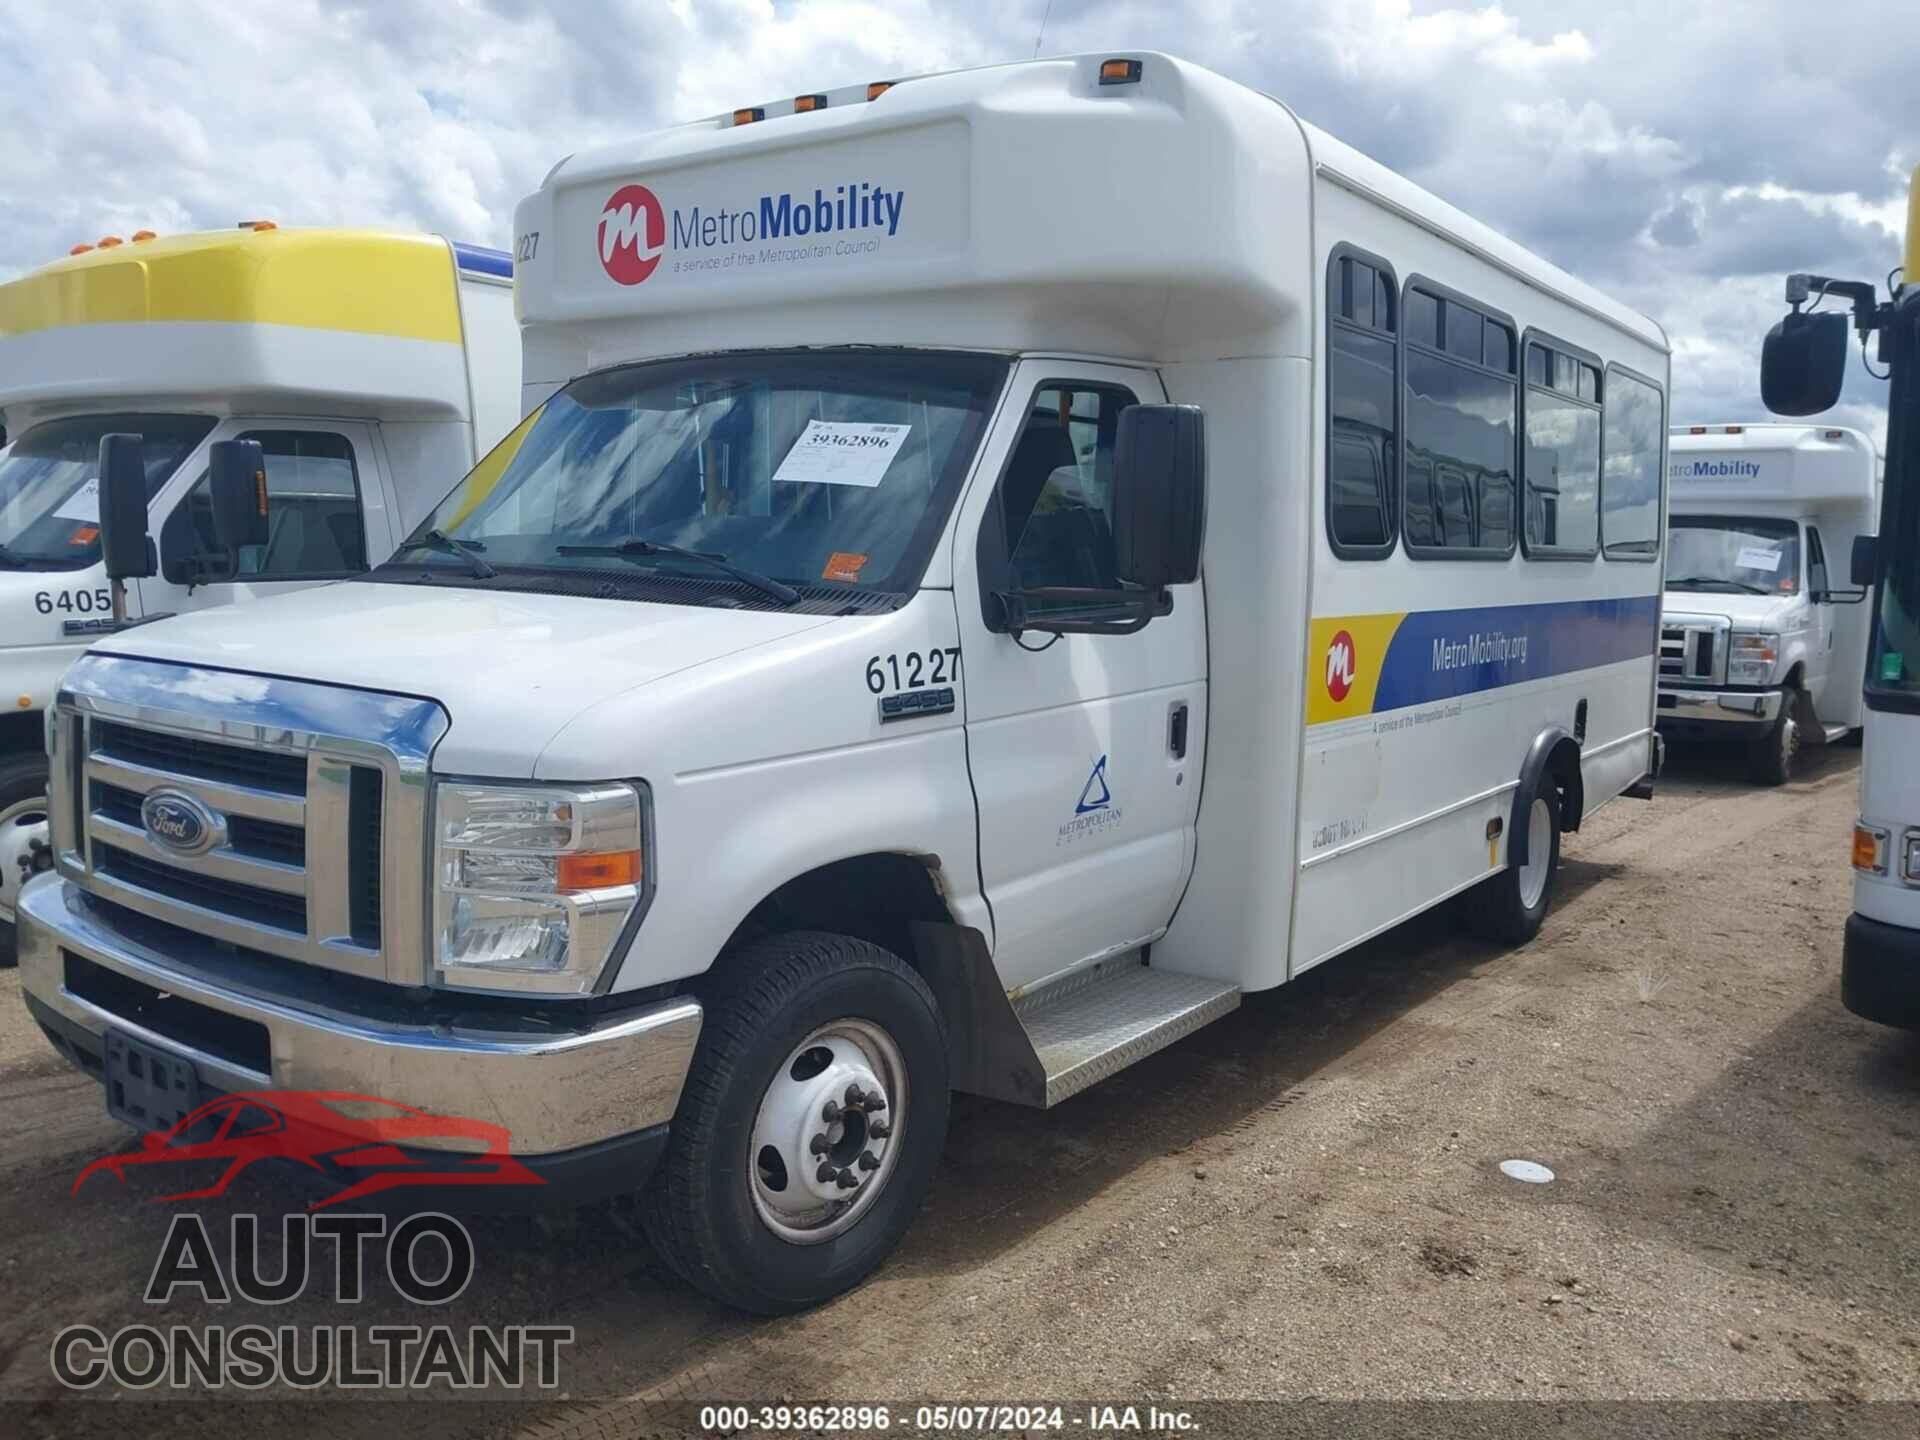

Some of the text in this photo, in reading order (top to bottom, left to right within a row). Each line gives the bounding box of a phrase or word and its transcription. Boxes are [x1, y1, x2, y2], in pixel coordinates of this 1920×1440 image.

[673, 182, 904, 251] MetroMobility
[682, 257, 720, 272] service
[722, 253, 737, 268] of
[738, 250, 755, 266] the
[758, 244, 832, 265] Metropolitan
[835, 238, 881, 256] Council
[807, 433, 890, 449] 39362896
[1670, 460, 1761, 478] troMobility
[35, 588, 112, 614] 6405
[1432, 631, 1528, 673] MetroMobility.org
[866, 647, 961, 694] 61227
[153, 806, 188, 838] Ford
[1058, 808, 1121, 836] METROPOLITAN
